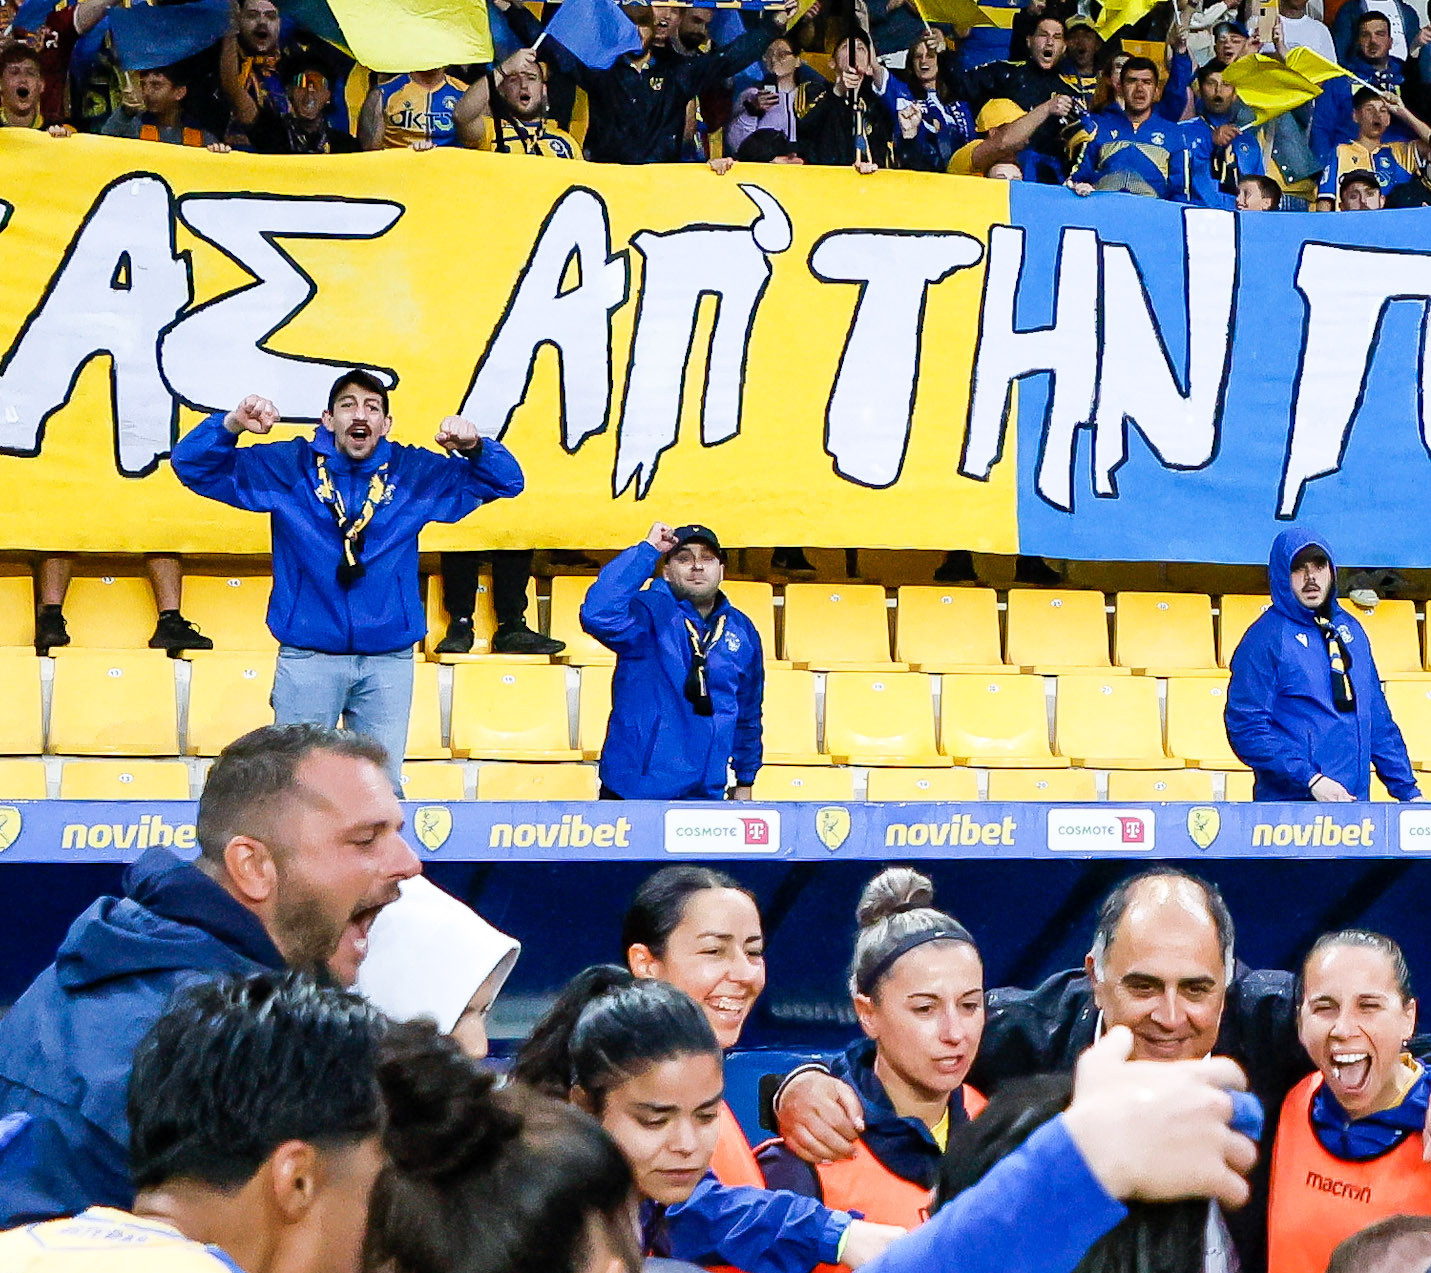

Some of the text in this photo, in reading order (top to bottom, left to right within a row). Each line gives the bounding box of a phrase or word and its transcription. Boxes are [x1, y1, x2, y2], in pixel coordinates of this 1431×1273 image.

[808, 207, 1241, 517] ΤΗΝ
[61, 815, 198, 850] novibe
[489, 814, 632, 849] novibet
[675, 826, 738, 838] COSMOTE
[885, 814, 1018, 847] novibet
[1057, 824, 1116, 837] COSMOTE
[1252, 814, 1376, 848] novibet
[1305, 1170, 1372, 1204] macron
